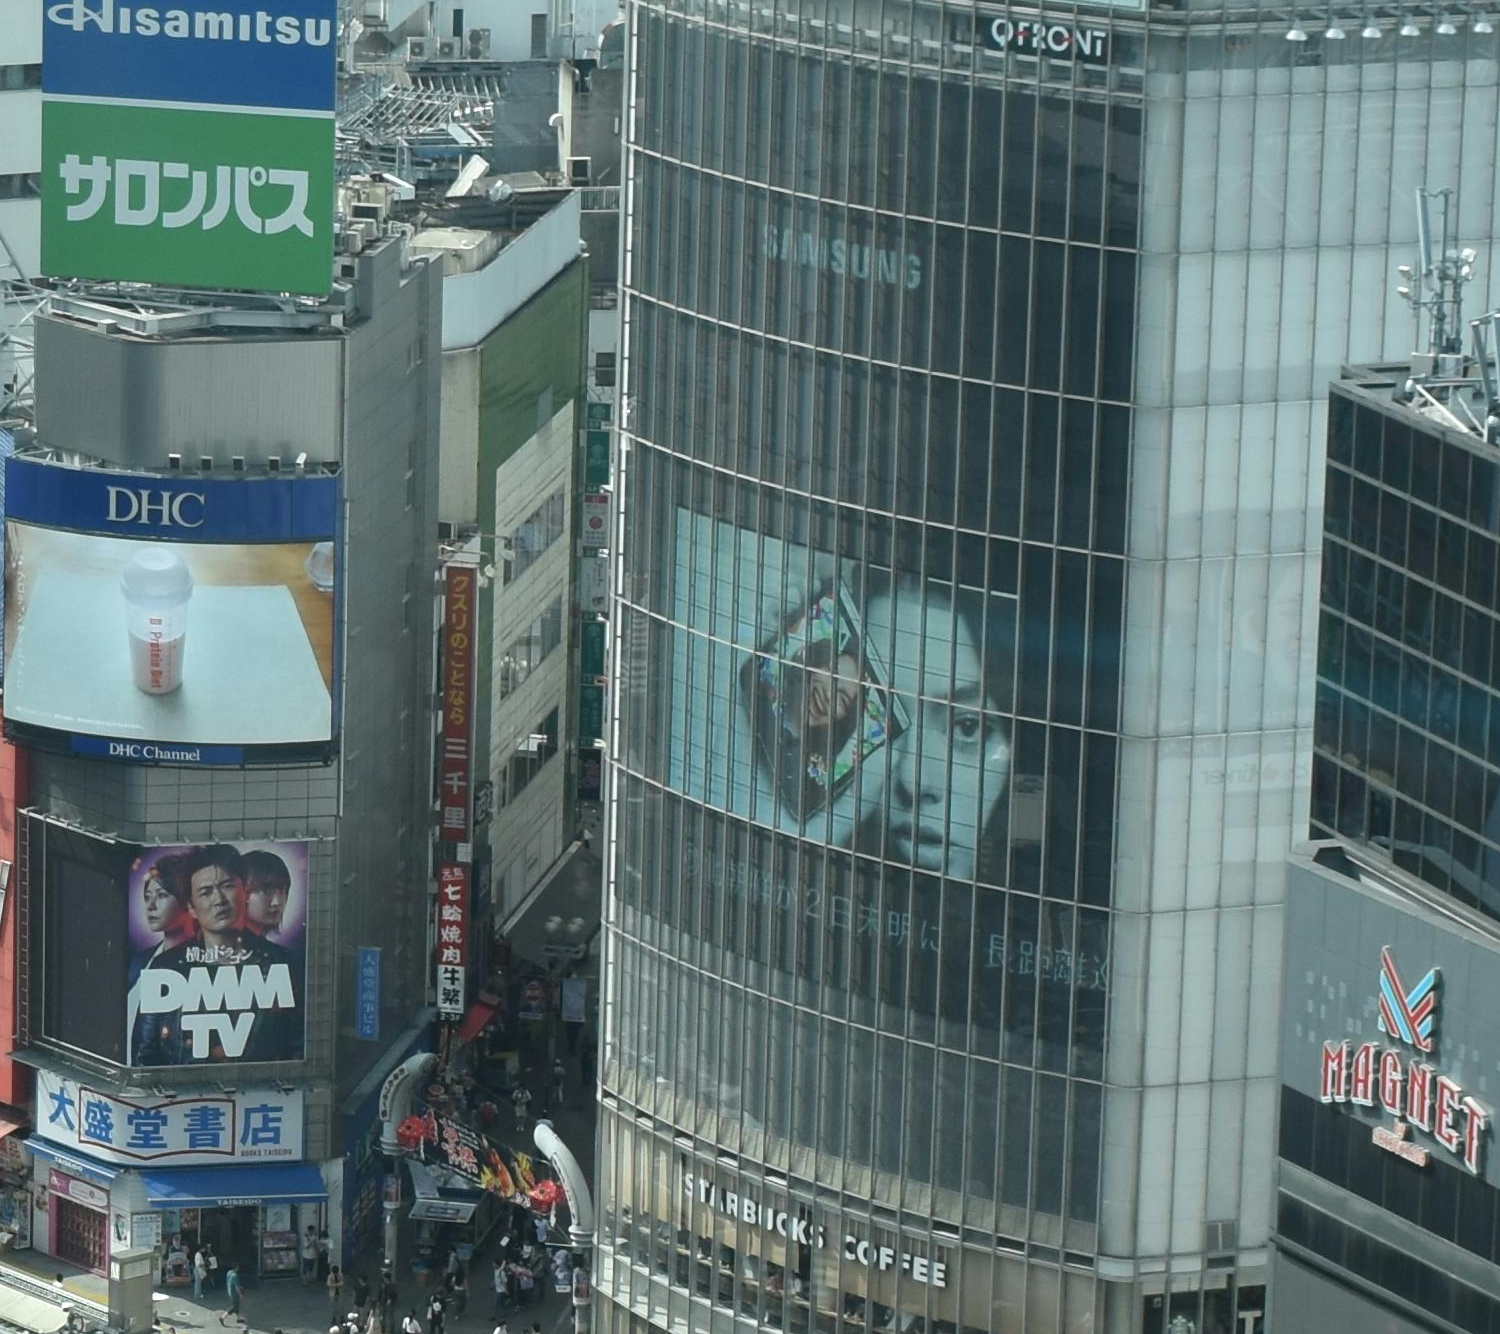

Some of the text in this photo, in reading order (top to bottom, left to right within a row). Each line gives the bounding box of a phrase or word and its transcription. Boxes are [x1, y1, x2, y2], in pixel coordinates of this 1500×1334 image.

[58, 153, 315, 239] サロンパス
[106, 484, 207, 528] DHC
[442, 574, 468, 829] クスリのことなら 三千里
[108, 742, 201, 763] DHC Channel
[440, 883, 464, 964] 七輪焼肉
[138, 963, 296, 1015] DMM
[181, 1012, 256, 1060] TV
[47, 1088, 284, 1153] 大盛堂書店
[1319, 1036, 1493, 1174] MAGNET
[683, 1171, 948, 1288] STARBUCKS COFFEE
